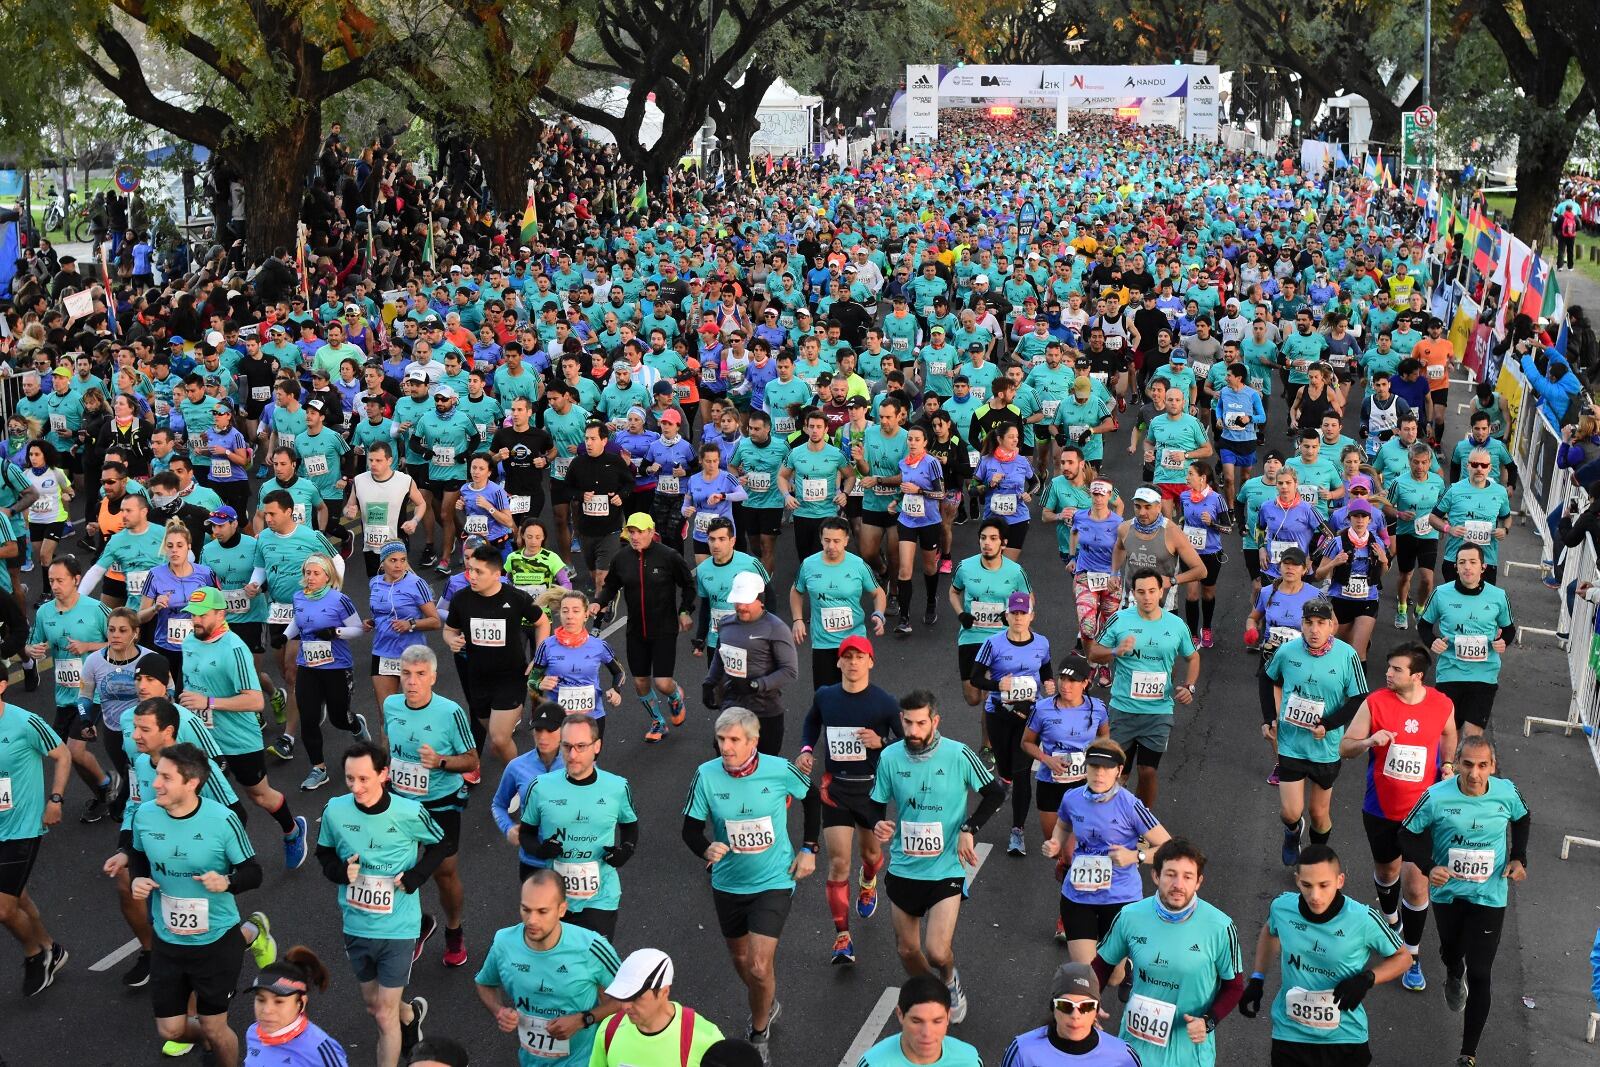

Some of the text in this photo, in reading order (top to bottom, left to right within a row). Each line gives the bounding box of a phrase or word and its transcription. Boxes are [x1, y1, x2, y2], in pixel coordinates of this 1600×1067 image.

[1136, 78, 1166, 86] NANDU
[775, 421, 796, 431] 13341
[308, 462, 326, 474] 5108
[805, 487, 824, 498] 4504
[584, 502, 609, 512] 13720
[904, 503, 922, 513] 1452
[993, 501, 1014, 512] 1454
[1129, 551, 1157, 564] ARG
[1129, 561, 1158, 569] ARGENTINA
[824, 615, 852, 628] 19731
[974, 611, 999, 623] 3842
[475, 628, 502, 641] 6130
[1455, 645, 1487, 658] 17584
[57, 670, 81, 682] 4009
[1007, 687, 1033, 701] 1299
[1133, 682, 1165, 695] 17392
[560, 697, 593, 711] 20783
[830, 740, 862, 755] 5386
[1388, 757, 1422, 776] 4965
[391, 768, 428, 790] 12519
[917, 803, 943, 813] Naranja
[567, 834, 598, 843] Naranja
[730, 831, 773, 848] 18336
[904, 836, 942, 852] 17269
[361, 863, 393, 872] Naranja
[1453, 859, 1489, 876] 8605
[1072, 868, 1111, 884] 12136
[350, 885, 392, 906] 17066
[170, 911, 198, 929] 523
[1301, 963, 1337, 979] Naranja
[1147, 976, 1180, 991] Naranja
[531, 1006, 567, 1018] Naranja
[1292, 1003, 1334, 1022] 3856
[1127, 1009, 1170, 1039] 16949
[527, 1030, 557, 1051] 277
